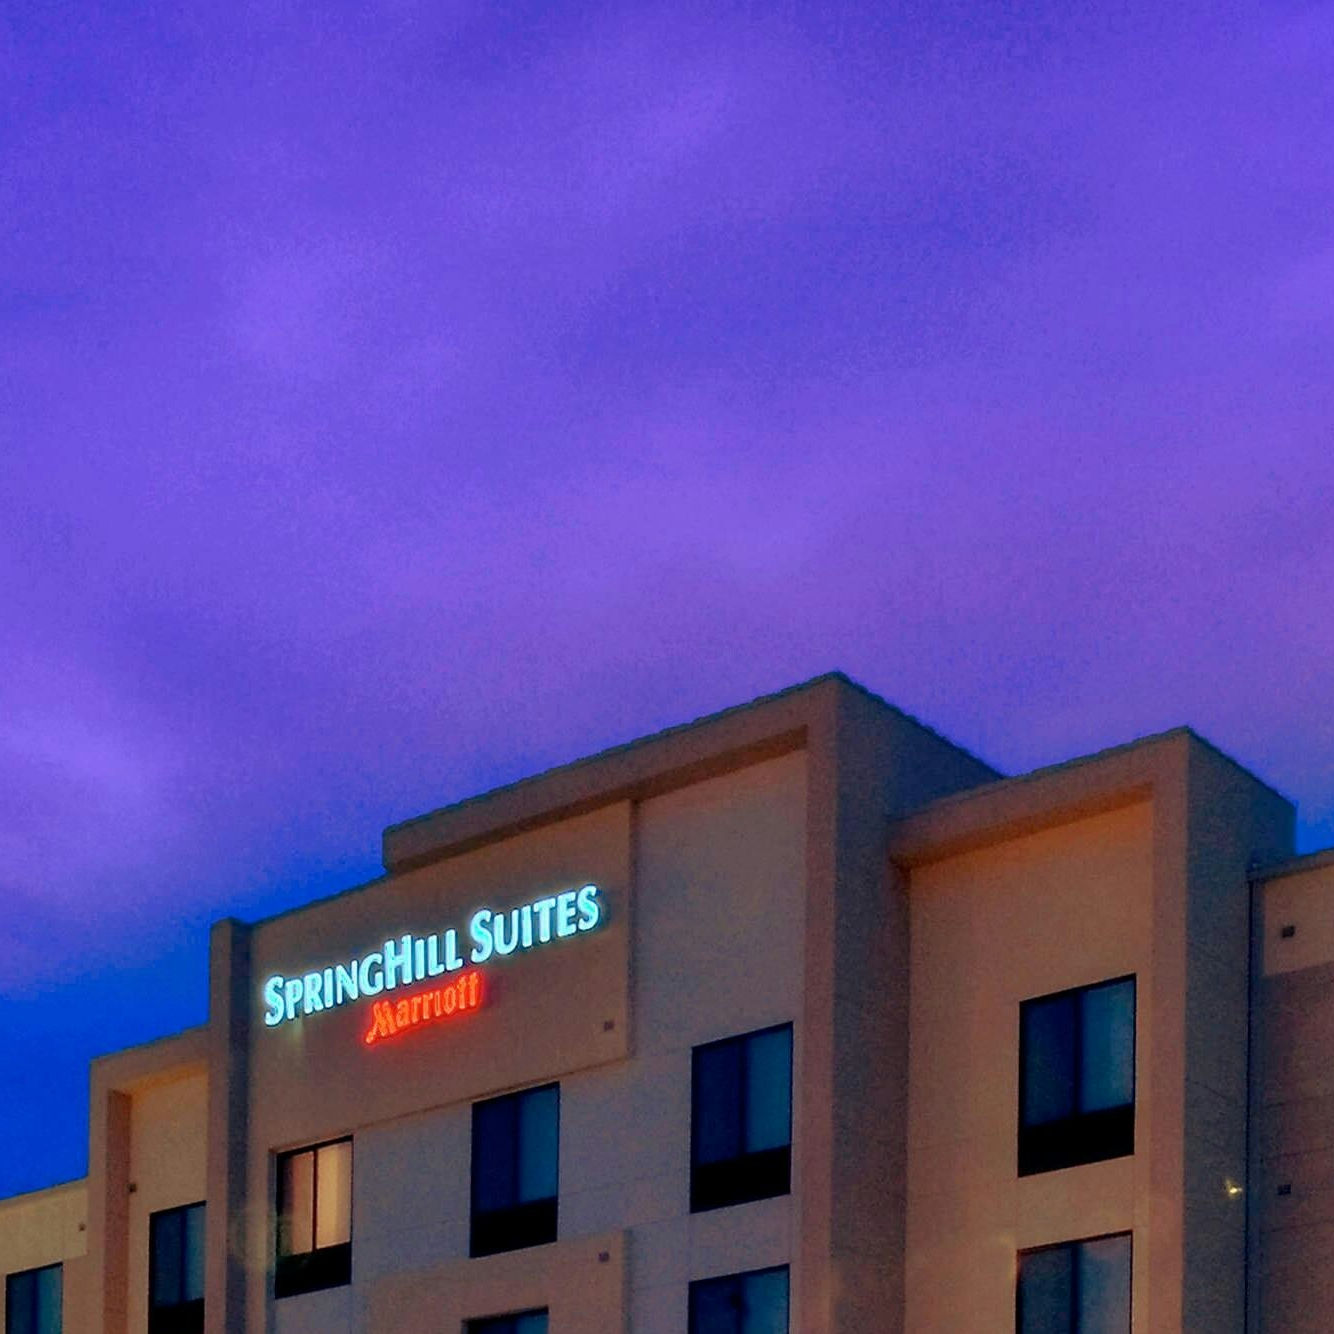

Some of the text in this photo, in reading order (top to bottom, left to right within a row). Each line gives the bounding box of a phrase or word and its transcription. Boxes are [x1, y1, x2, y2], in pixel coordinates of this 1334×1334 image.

[264, 884, 600, 1026] SPRINGHILL SUITES
[366, 971, 481, 1043] Marriott
